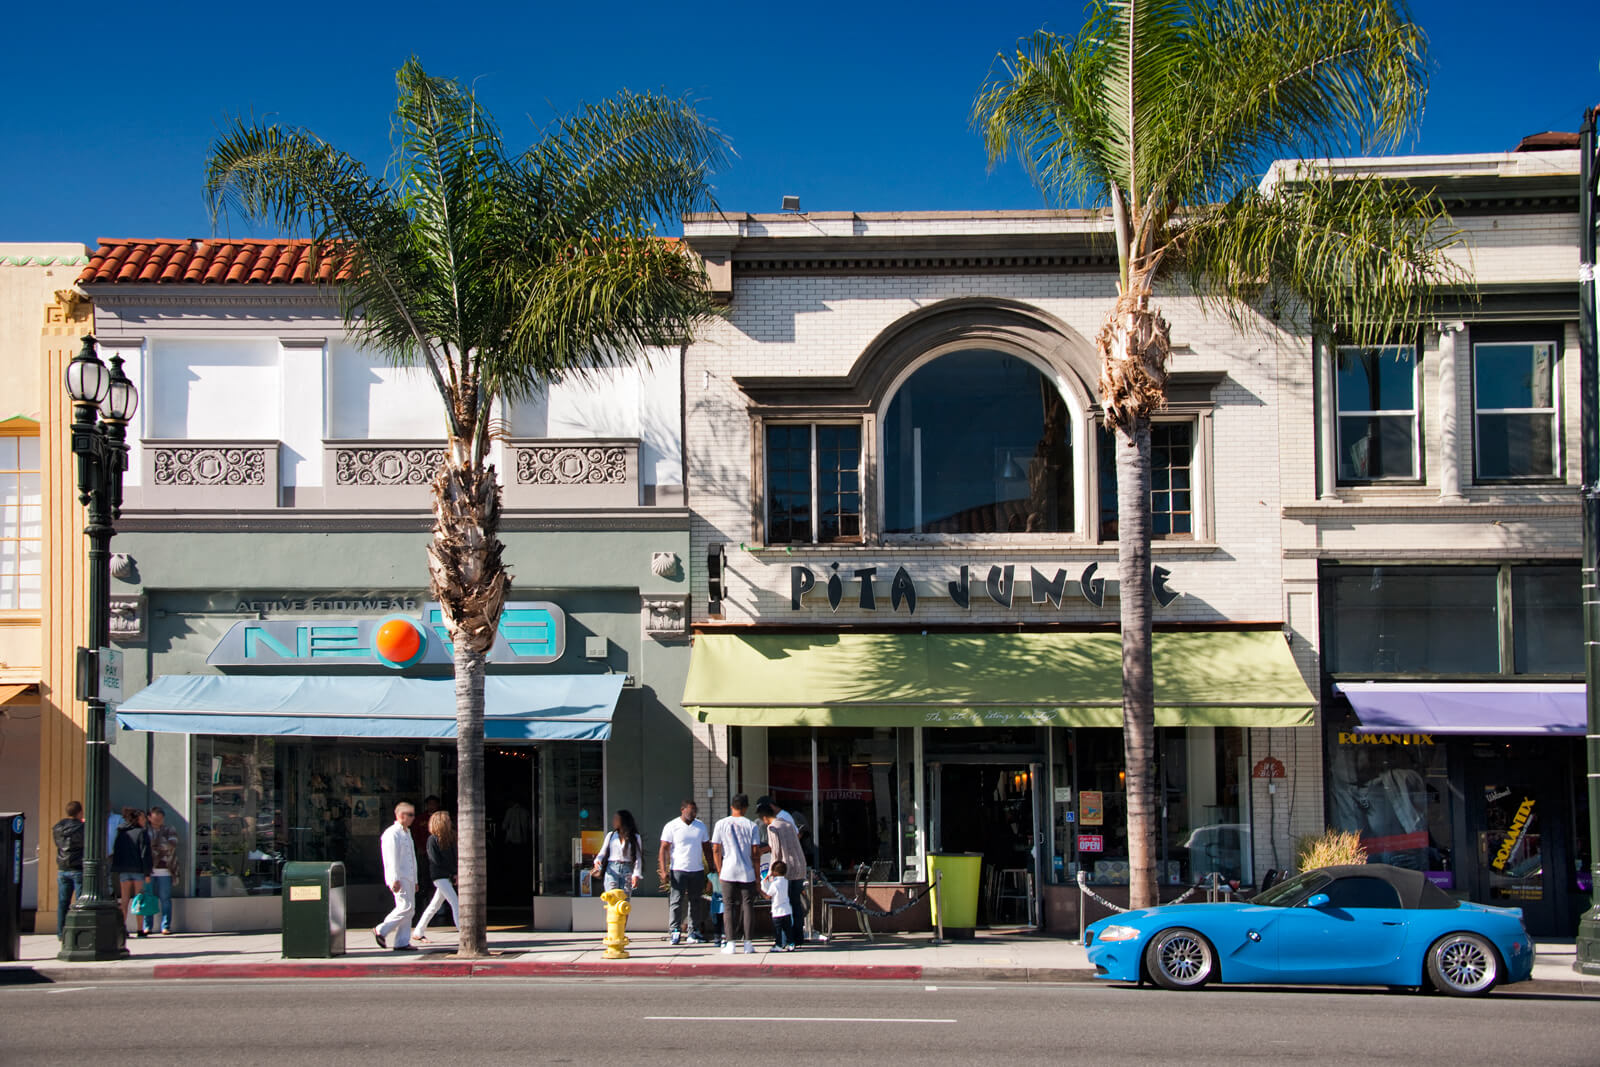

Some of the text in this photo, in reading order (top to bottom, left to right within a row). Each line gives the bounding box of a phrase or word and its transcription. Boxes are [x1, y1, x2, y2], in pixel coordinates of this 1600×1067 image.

[949, 561, 1180, 610] JUNGE
[236, 599, 417, 612] ACTIVE FOOTWEAR
[105, 664, 117, 676] PAY
[104, 676, 120, 689] HERE
[1492, 796, 1536, 870] ROMANTIX
[1080, 841, 1100, 850] OPEN
